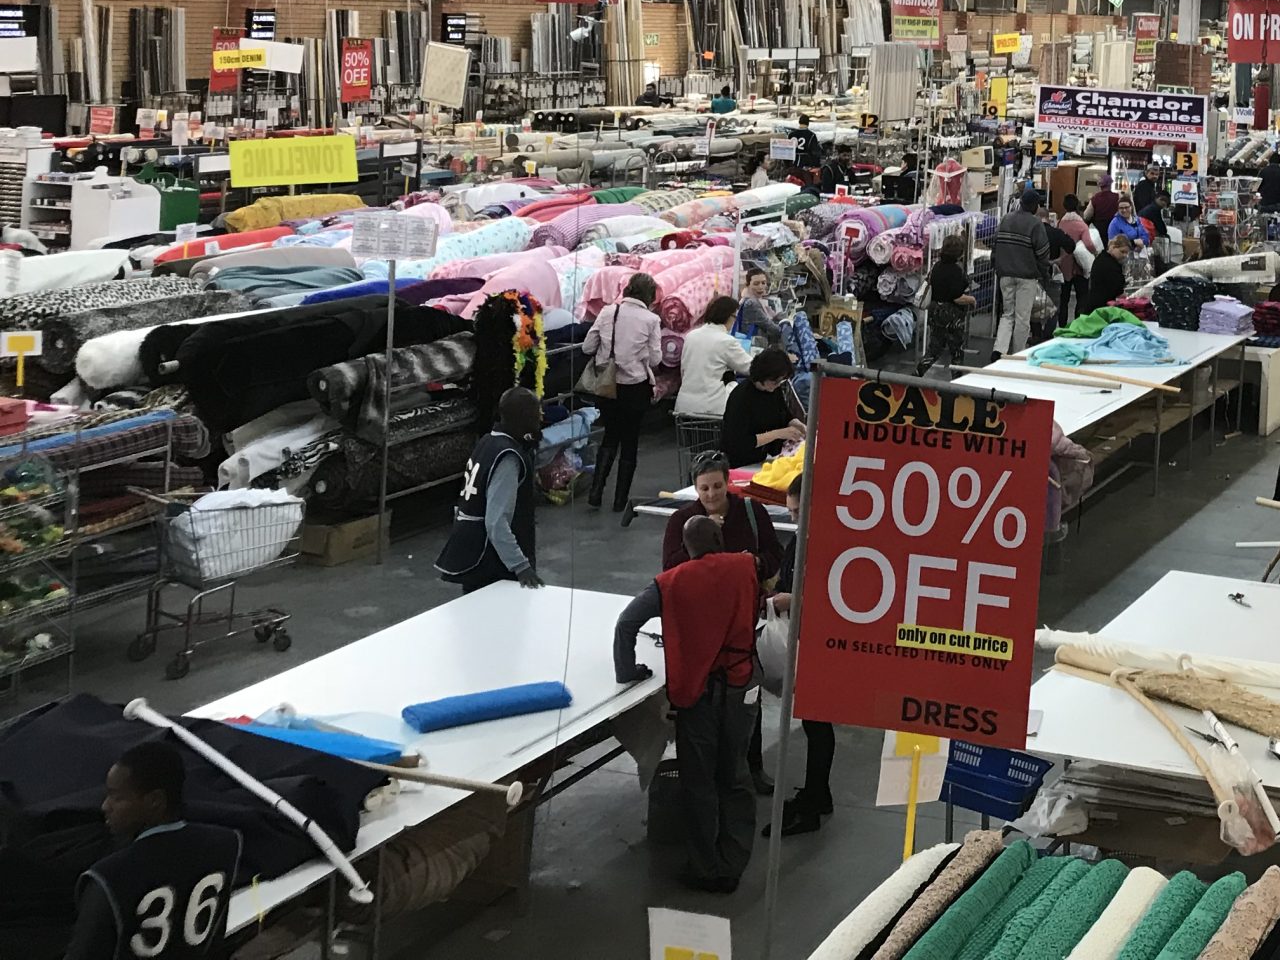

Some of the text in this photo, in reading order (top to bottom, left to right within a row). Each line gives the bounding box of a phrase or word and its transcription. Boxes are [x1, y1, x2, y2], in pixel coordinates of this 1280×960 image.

[1232, 12, 1255, 41] ON
[219, 54, 262, 64] 150cm DENIM
[344, 51, 370, 67] 50%
[344, 68, 369, 84] OFF
[981, 102, 998, 116] 10
[1075, 92, 1193, 112] Chamdor
[860, 114, 879, 128] 12
[1076, 105, 1143, 121] faktry
[1148, 111, 1202, 123] sales
[1045, 116, 1197, 133] LARGEST SELECTION OF FABRICS
[1057, 124, 1186, 138] WWW.CHAMDOR.COM
[1041, 141, 1053, 155] 2
[1182, 154, 1193, 169] 3
[856, 381, 1007, 437] SALE
[843, 421, 1027, 458] INDULGE WITH
[835, 455, 1027, 550] 50%
[827, 546, 1017, 632] OFF
[898, 627, 1008, 654] only on cut price
[826, 638, 1008, 672] ON SELECTED ITEMS ONLY
[901, 696, 998, 736] DRESS
[130, 872, 225, 958] 36
